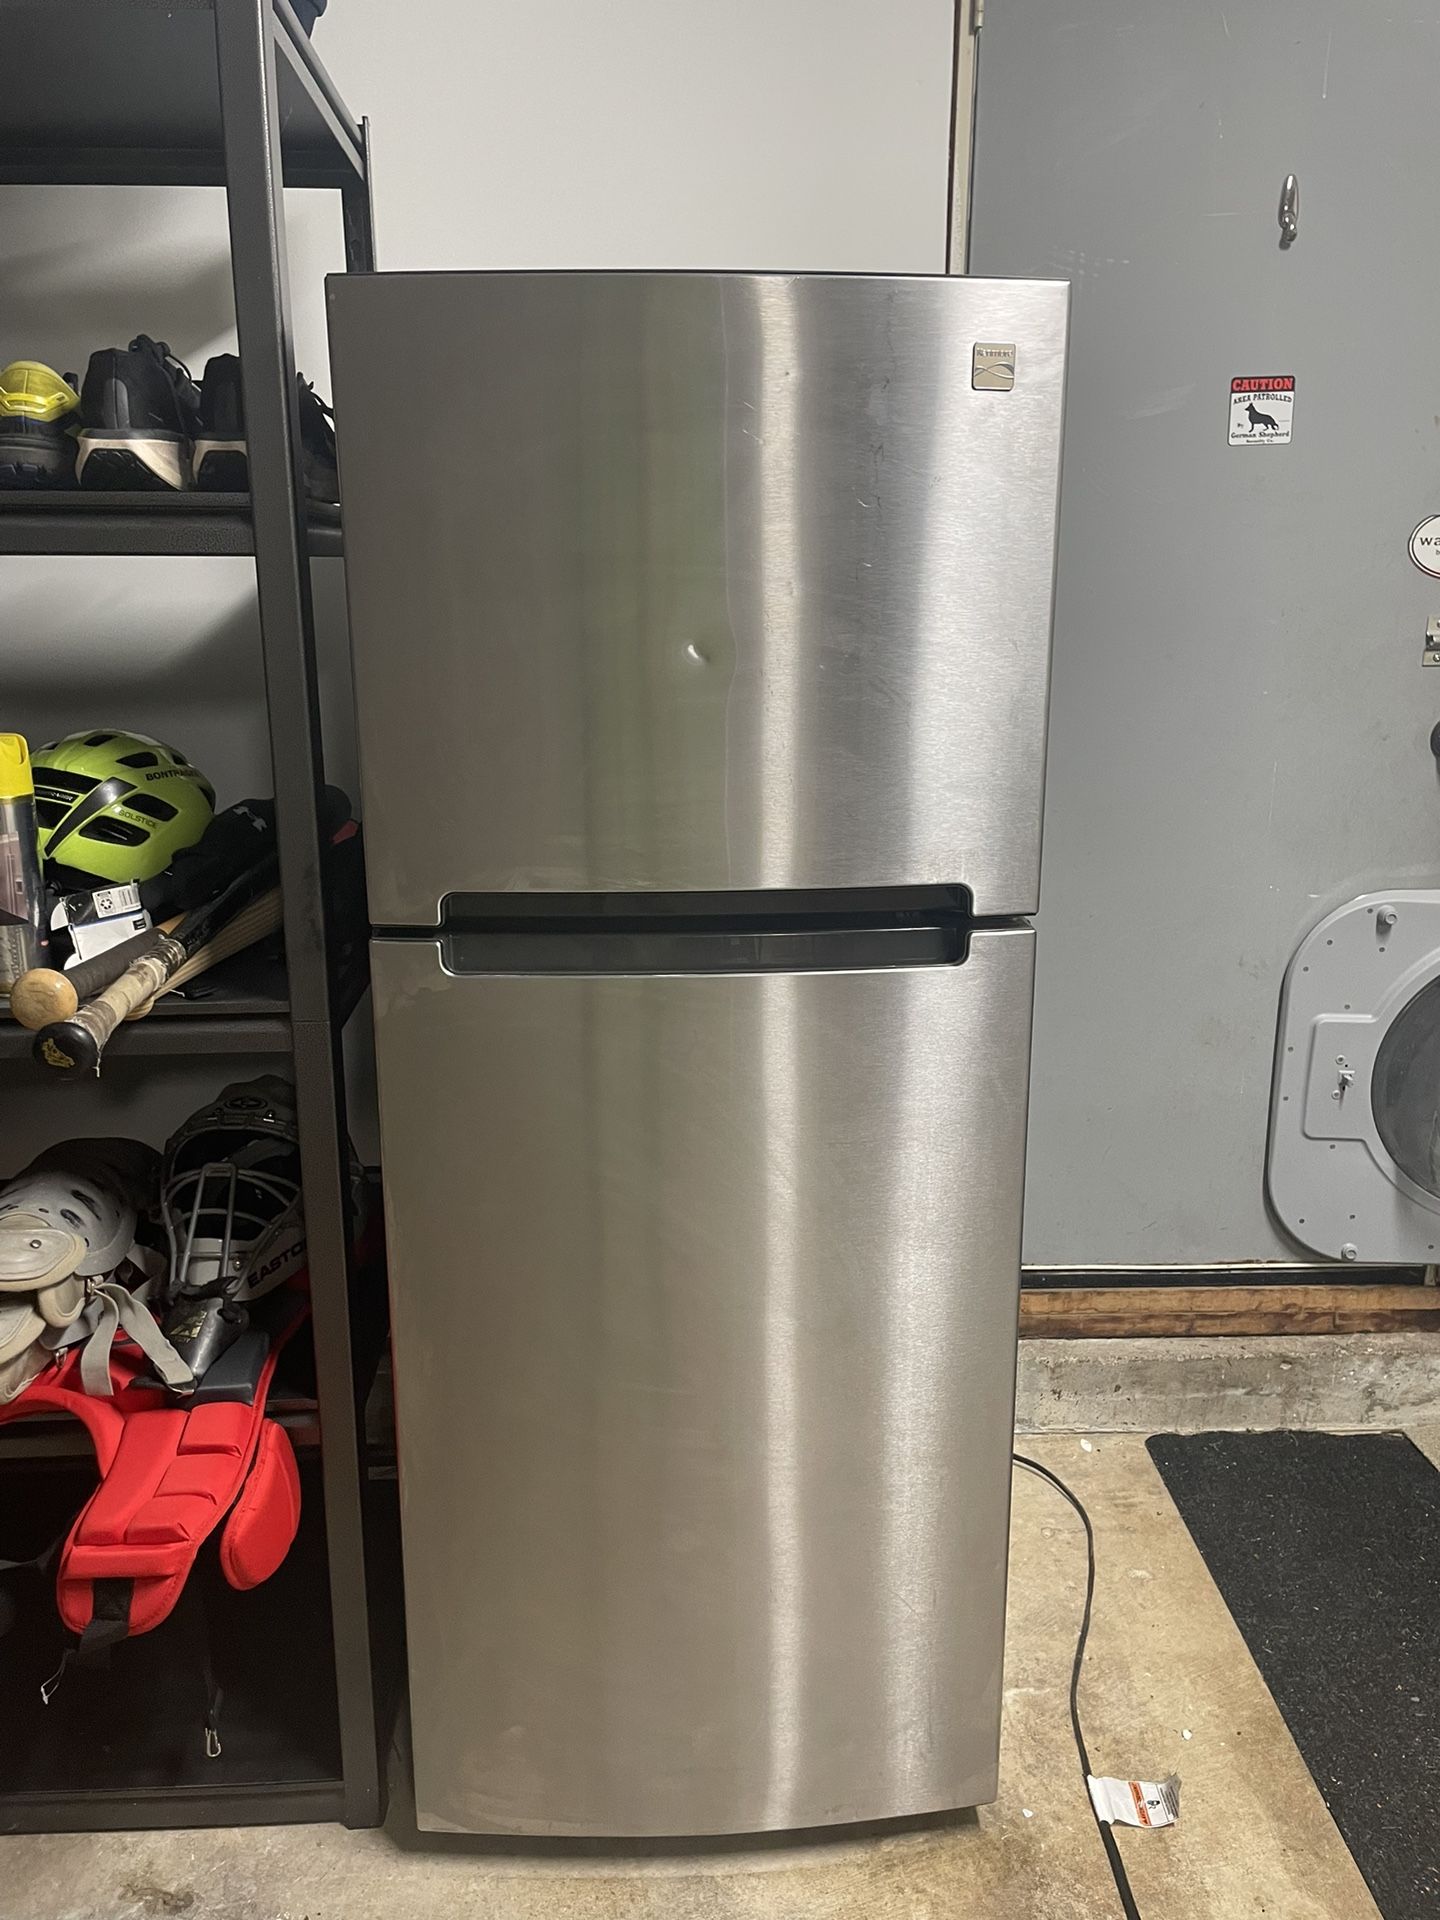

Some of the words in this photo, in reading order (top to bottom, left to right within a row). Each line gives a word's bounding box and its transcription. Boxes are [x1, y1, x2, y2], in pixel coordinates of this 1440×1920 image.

[1232, 378, 1293, 391] CAUTION
[1233, 394, 1251, 405] AREA
[1253, 393, 1292, 403] PATROLLED
[1258, 430, 1290, 439] Shepherd
[118, 808, 158, 829] SOLSTICE
